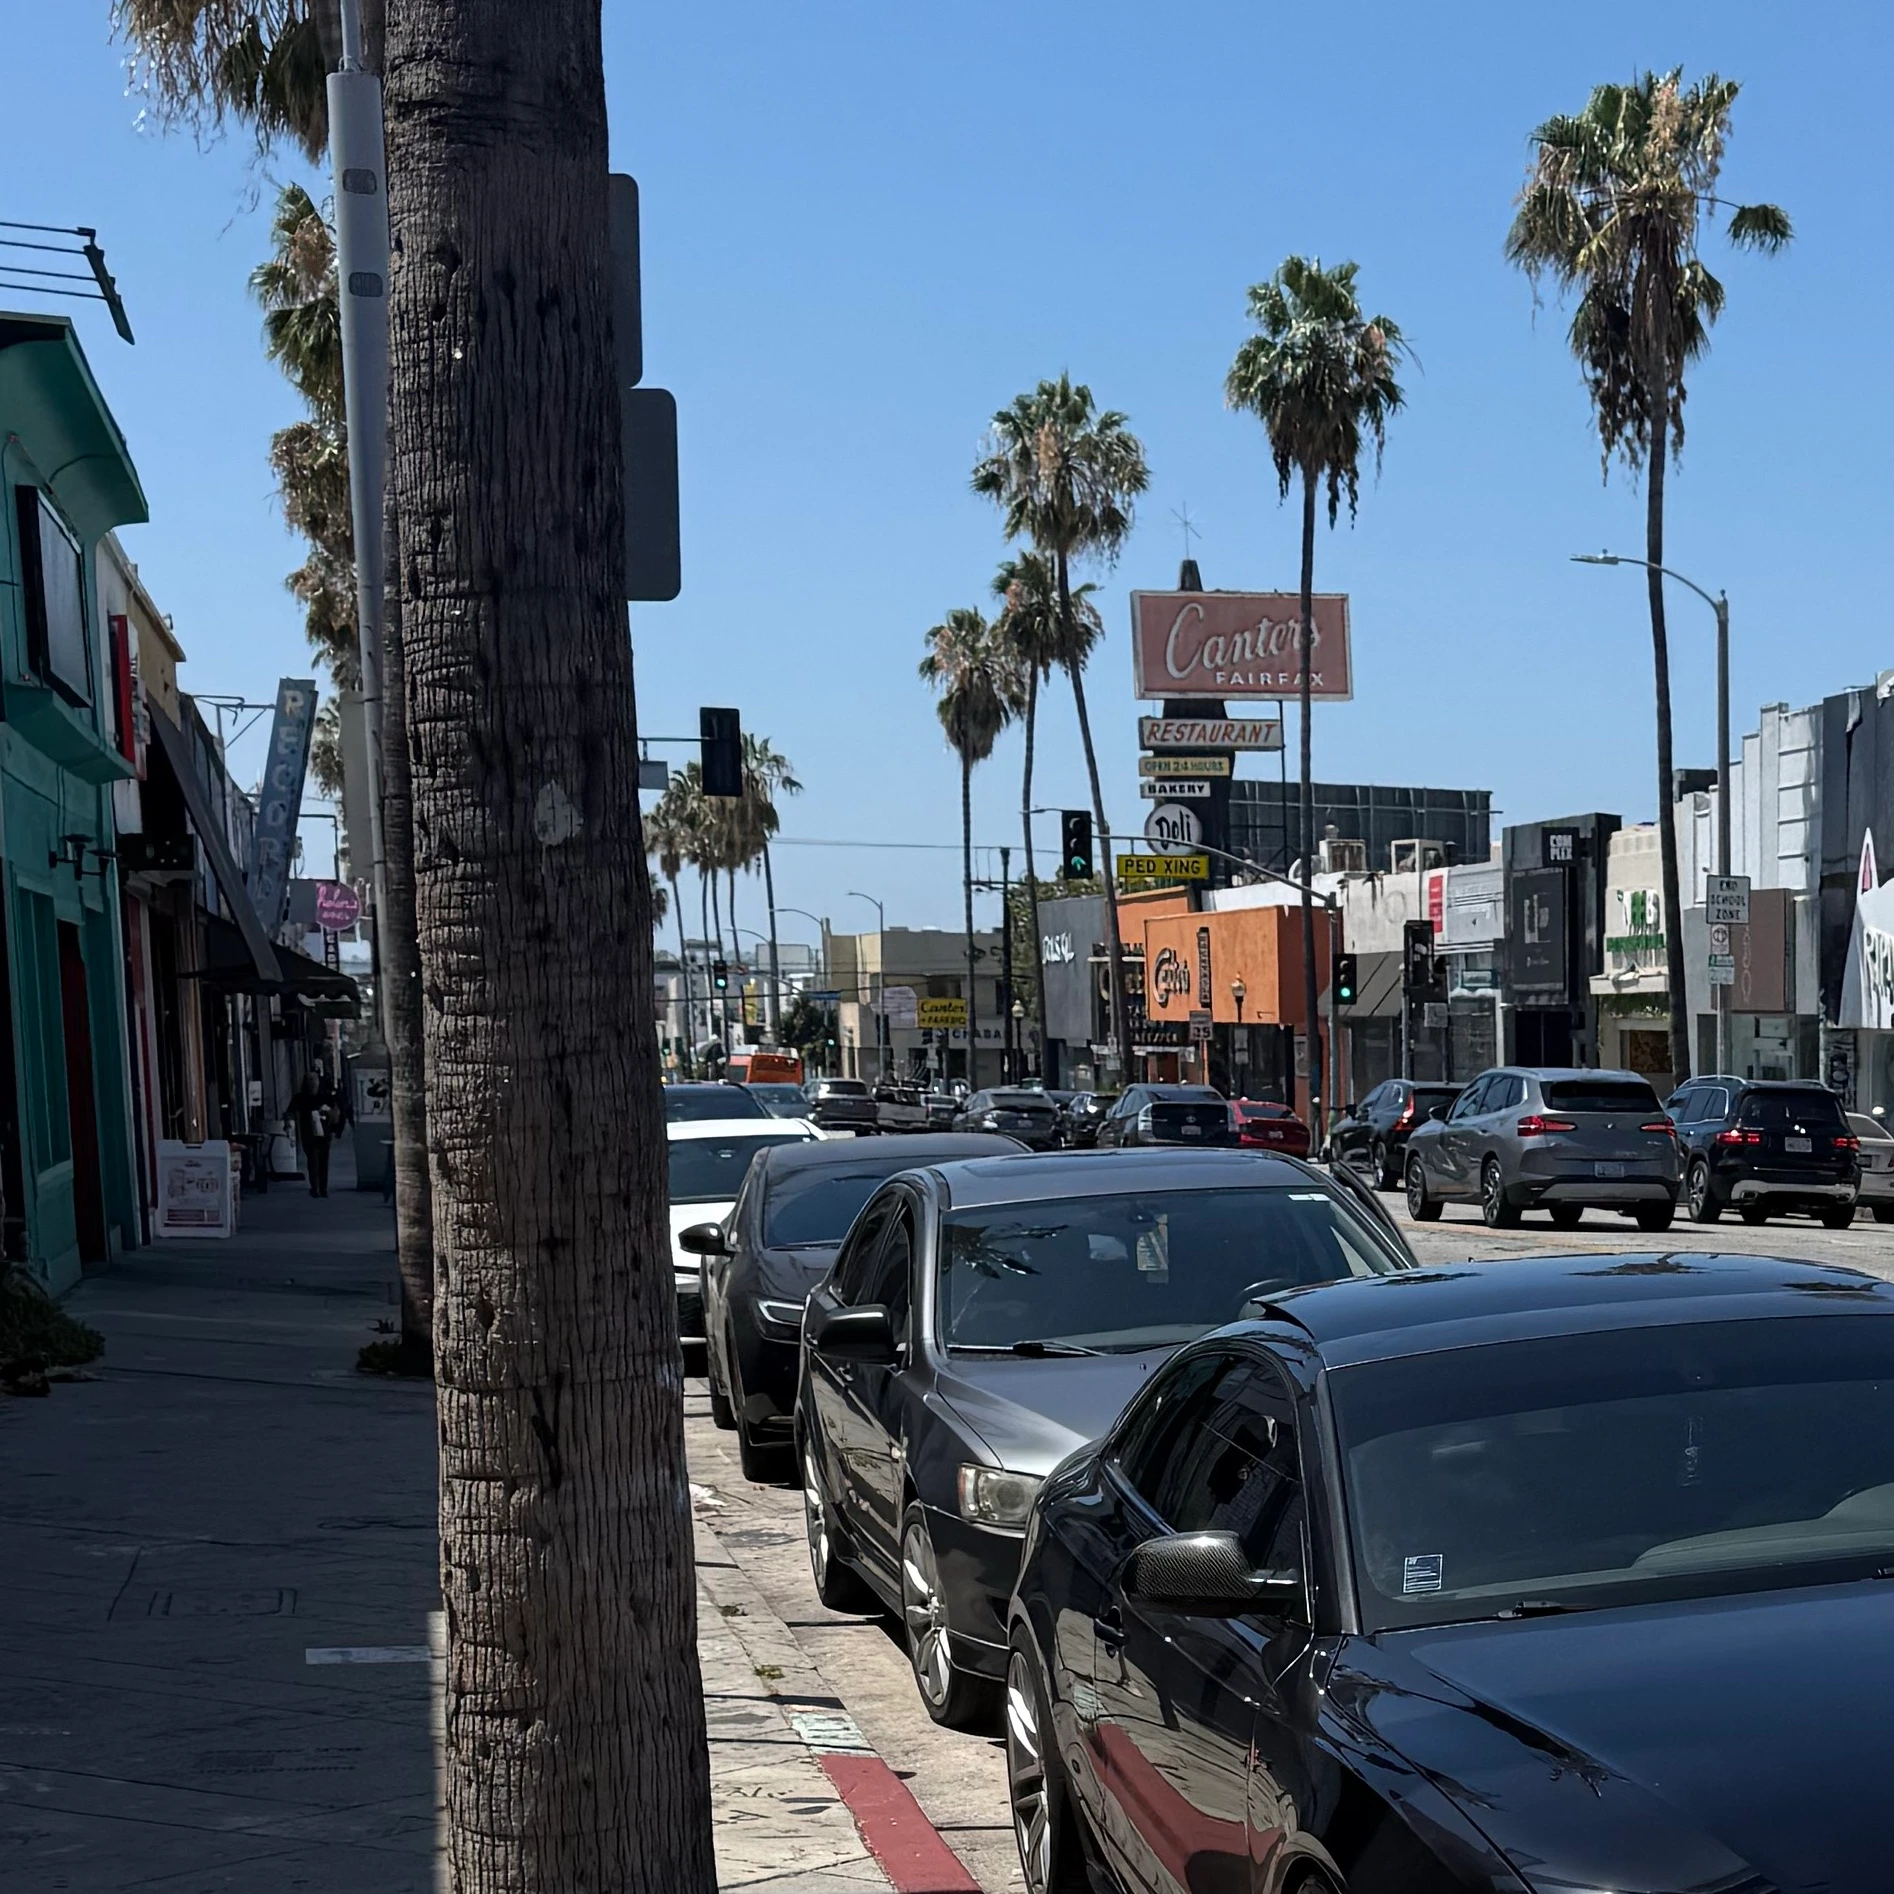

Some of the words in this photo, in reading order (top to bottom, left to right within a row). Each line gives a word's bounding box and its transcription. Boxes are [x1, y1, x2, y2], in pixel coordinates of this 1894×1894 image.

[1146, 722, 1279, 744] RESTAURANT
[1148, 784, 1205, 794] BAKERY
[1155, 809, 1193, 850] Deli
[1124, 858, 1157, 874] PED
[1164, 858, 1201, 875] XING
